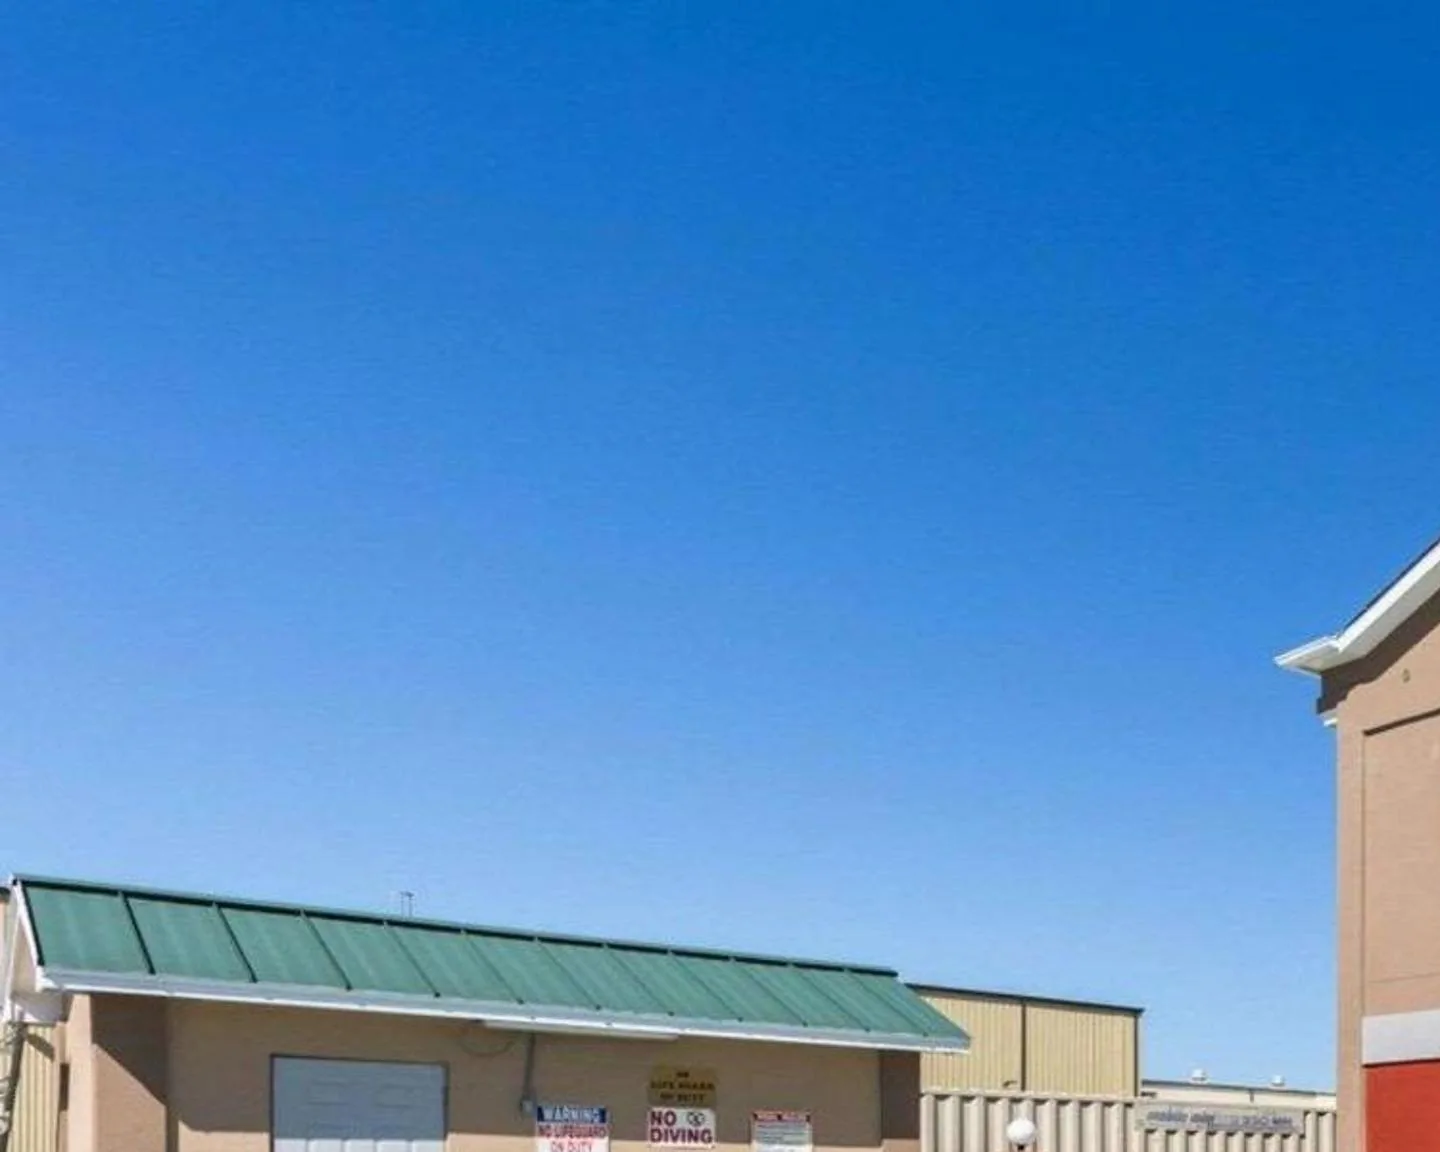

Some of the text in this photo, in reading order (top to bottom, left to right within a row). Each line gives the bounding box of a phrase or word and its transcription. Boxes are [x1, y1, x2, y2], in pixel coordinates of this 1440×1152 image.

[543, 1106, 600, 1123] WARNING
[650, 1110, 677, 1127] NO
[539, 1125, 607, 1139] NO LIFEGUARD
[650, 1128, 712, 1144] DIVING
